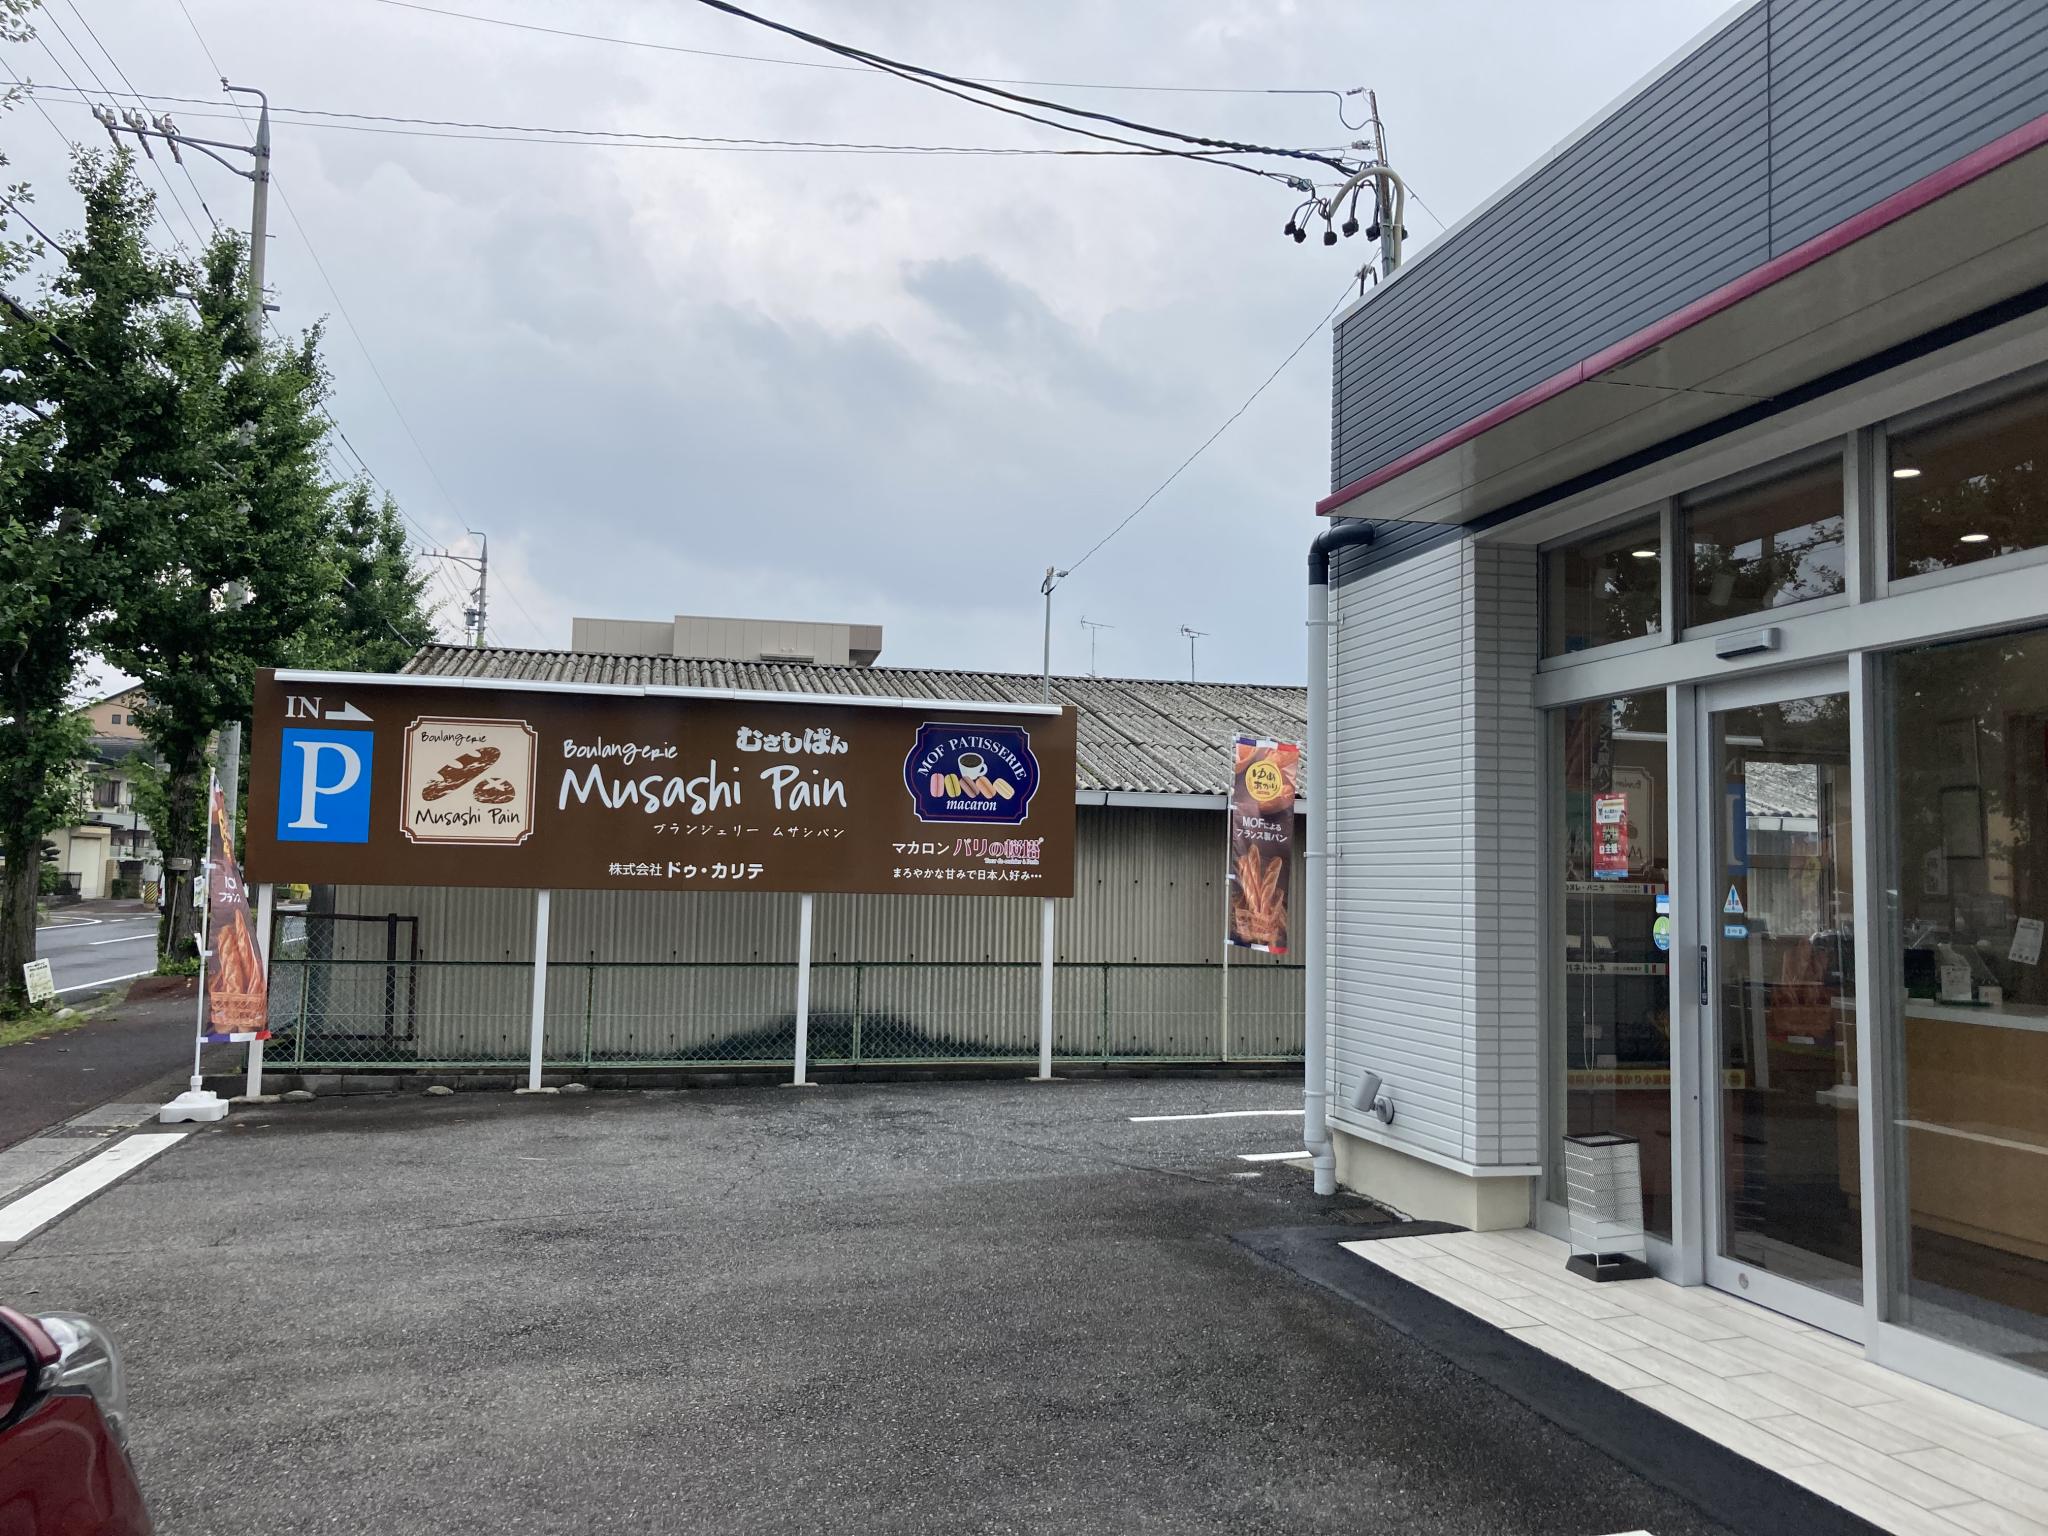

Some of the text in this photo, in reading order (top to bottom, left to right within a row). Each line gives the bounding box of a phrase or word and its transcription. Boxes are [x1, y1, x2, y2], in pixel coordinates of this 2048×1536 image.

[286, 696, 323, 719] IN
[421, 731, 487, 745] Boulangerie
[736, 726, 848, 754] むさしぱん
[563, 737, 678, 765] Boulangerie
[916, 736, 1028, 780] MOF PATISSERIE
[287, 741, 361, 829] P
[558, 758, 847, 815] Musashi Pain
[946, 798, 997, 811] macaron
[415, 807, 520, 826] Musashi Pain
[653, 823, 845, 839] ブランジェリー ムサシパン
[892, 840, 949, 855] マカロン
[608, 862, 763, 879] 株式会社 ドゥ・カリテ
